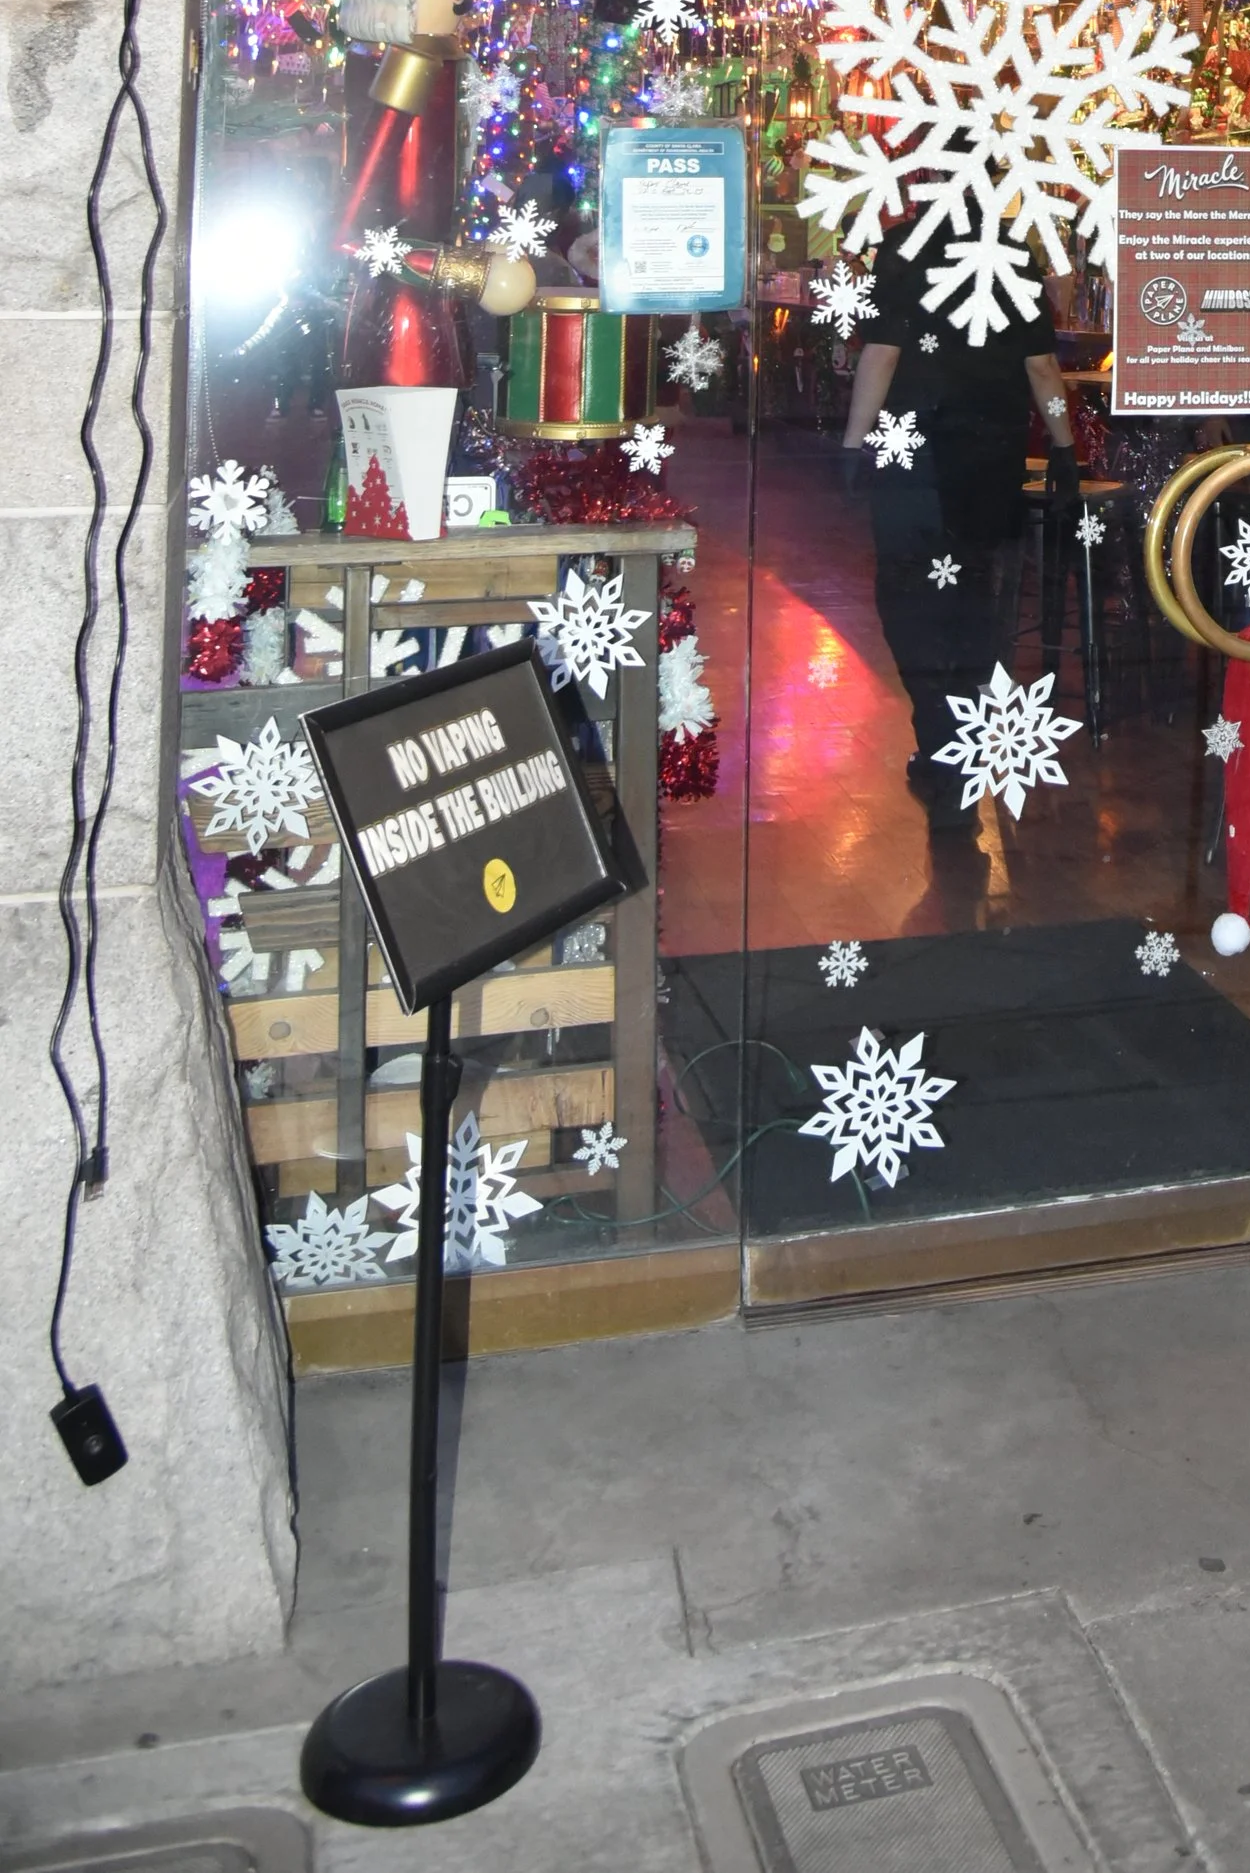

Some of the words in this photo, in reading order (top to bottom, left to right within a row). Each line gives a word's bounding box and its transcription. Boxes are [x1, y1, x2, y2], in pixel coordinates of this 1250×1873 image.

[646, 157, 701, 174] PASS
[1144, 153, 1244, 200] Miracle
[1118, 209, 1144, 221] They
[1145, 211, 1163, 221] say
[1164, 210, 1182, 220] the
[1183, 210, 1209, 220] More
[1210, 210, 1227, 220] the
[1118, 234, 1150, 247] Enjoy
[1151, 234, 1170, 245] the
[1172, 234, 1212, 245] Miracle
[1135, 251, 1148, 260] at
[1150, 251, 1171, 260] two
[1173, 250, 1185, 260] of
[1186, 252, 1205, 260] our
[1144, 280, 1176, 305] PAPER
[1153, 297, 1184, 321] PLANE
[1147, 345, 1171, 354] Paper
[1172, 345, 1195, 353] Plane
[1196, 345, 1211, 353] and
[1213, 345, 1245, 353] Miniboss
[1126, 356, 1138, 364] for
[1139, 356, 1150, 364] all
[1170, 356, 1199, 365] holiday
[1200, 356, 1221, 364] cheer
[1222, 356, 1236, 364] this
[1124, 391, 1176, 408] Happy
[387, 738, 431, 791] NO
[420, 708, 506, 776] VAPING
[357, 801, 445, 878] INSIDE
[435, 784, 486, 842] THE
[475, 750, 567, 822] BUILDING
[812, 1752, 913, 1786] WATER
[815, 1768, 924, 1805] METER
